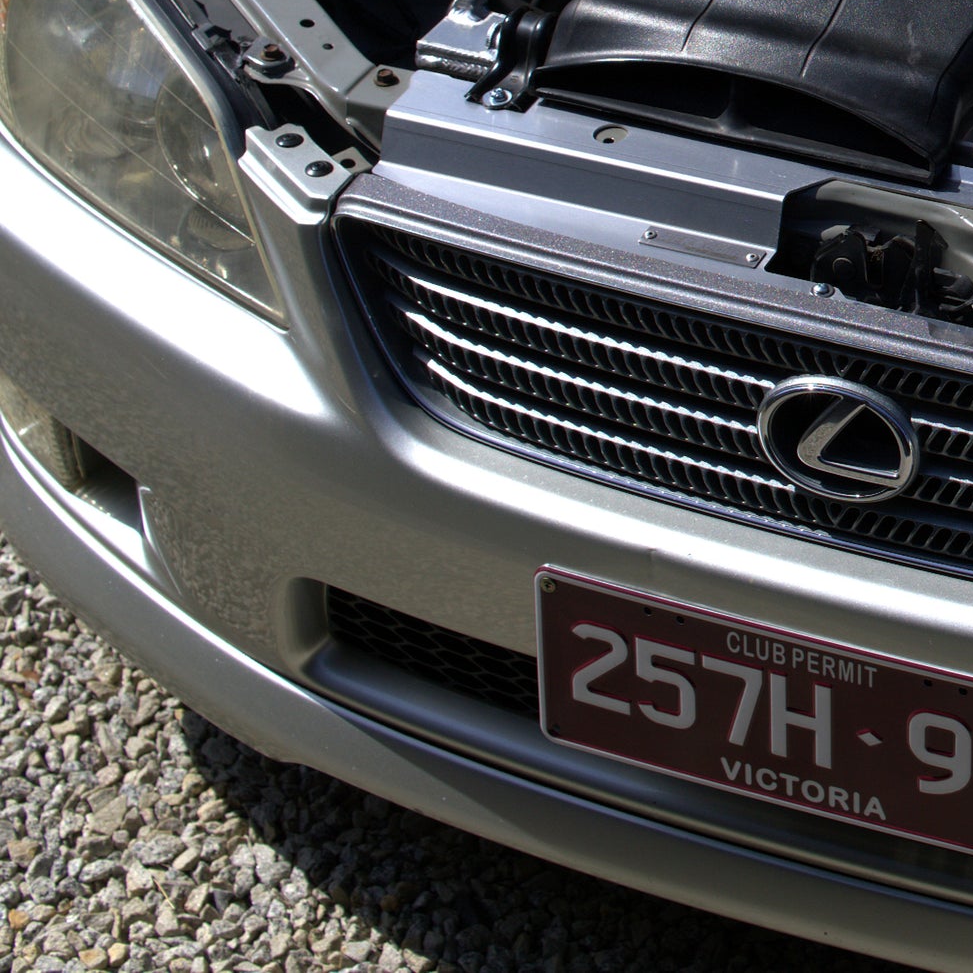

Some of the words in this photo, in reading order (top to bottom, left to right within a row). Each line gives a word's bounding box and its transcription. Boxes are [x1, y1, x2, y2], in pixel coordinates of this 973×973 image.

[726, 631, 786, 665] CLUB
[792, 647, 877, 688] PERMIT
[571, 623, 832, 769] 257H
[720, 757, 886, 821] VICTORIA
